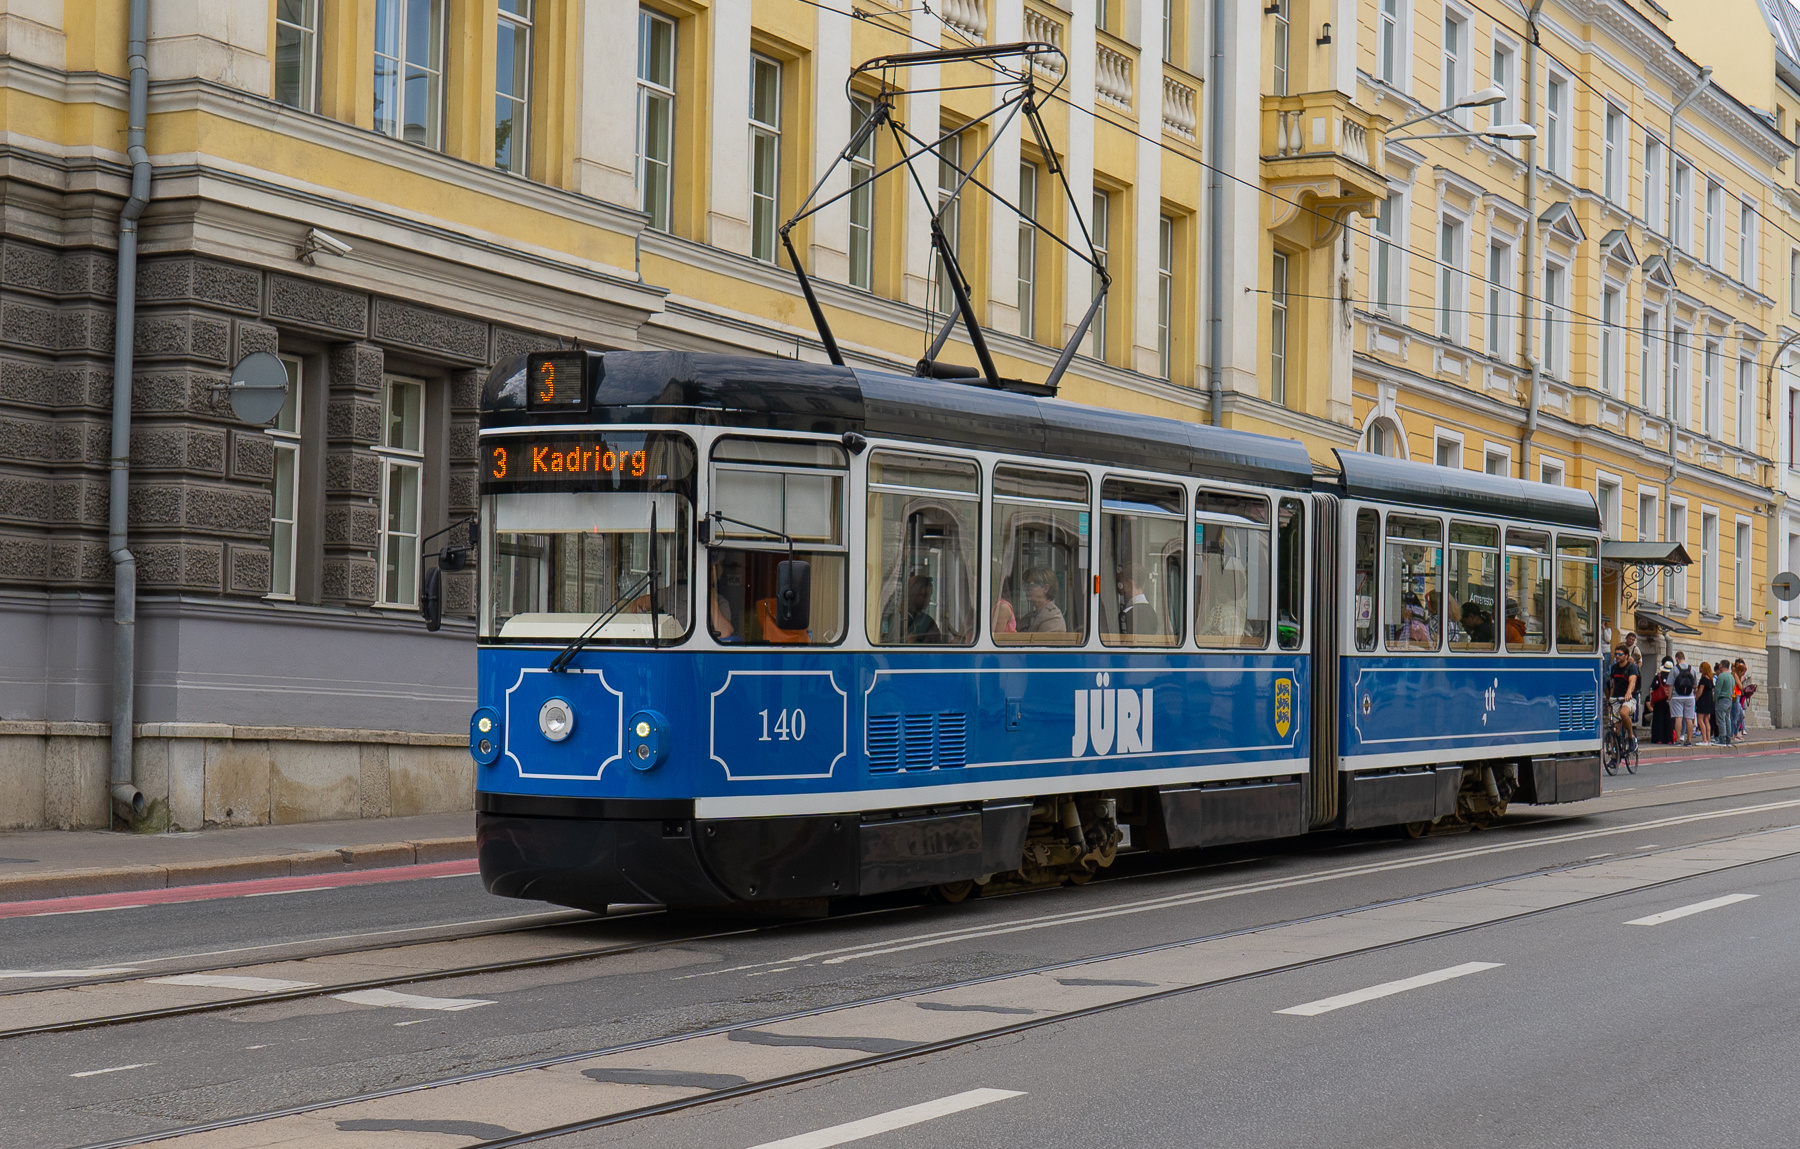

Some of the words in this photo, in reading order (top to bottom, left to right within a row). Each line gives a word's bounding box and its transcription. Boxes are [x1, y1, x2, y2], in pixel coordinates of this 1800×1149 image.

[540, 362, 555, 402] 3
[493, 447, 507, 479] 3
[533, 446, 646, 477] Kadriorg
[758, 708, 806, 741] 140
[1072, 672, 1154, 758] JÜRI
